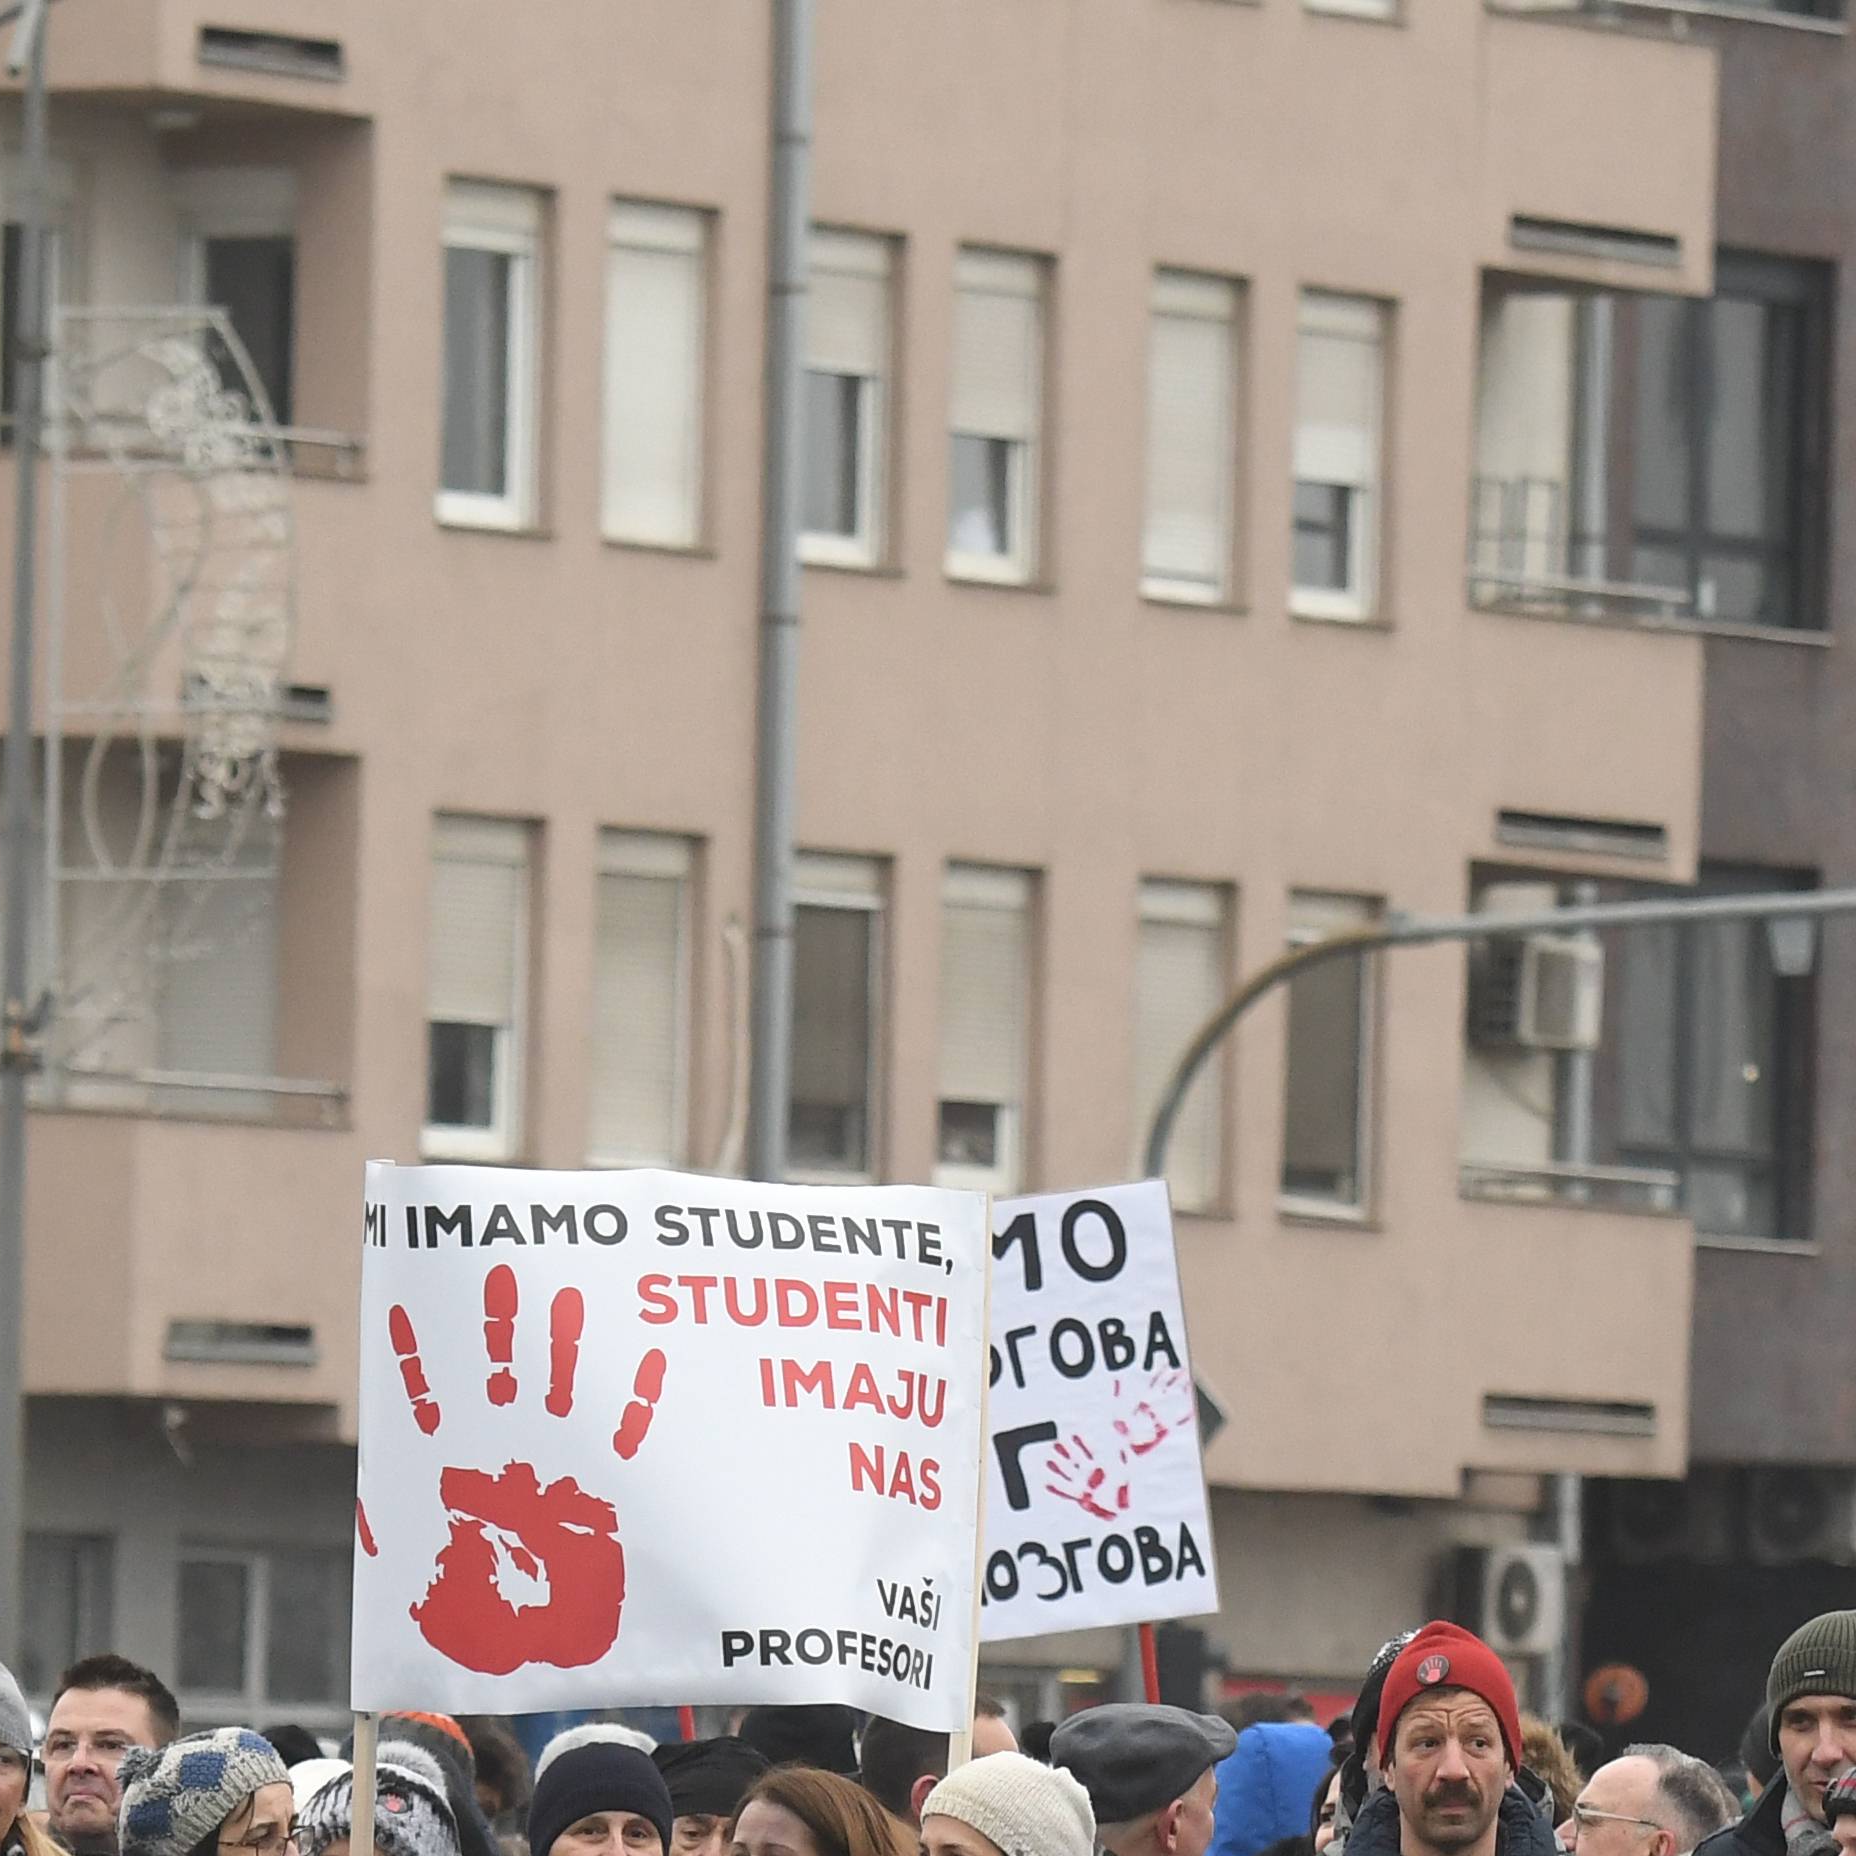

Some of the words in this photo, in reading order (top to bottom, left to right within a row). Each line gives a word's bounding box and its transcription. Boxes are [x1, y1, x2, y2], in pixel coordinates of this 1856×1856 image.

[363, 1201, 387, 1248] MI
[405, 1203, 629, 1249] IMAMO
[654, 1204, 954, 1276] STUDENTE,
[638, 1272, 948, 1348] STUDENTI
[758, 1357, 947, 1430] IMAJU
[848, 1442, 943, 1512] NAS
[981, 1521, 1207, 1607] ОЗГОВА
[876, 1576, 941, 1632] VAŠI
[721, 1628, 934, 1691] PROFESORI
